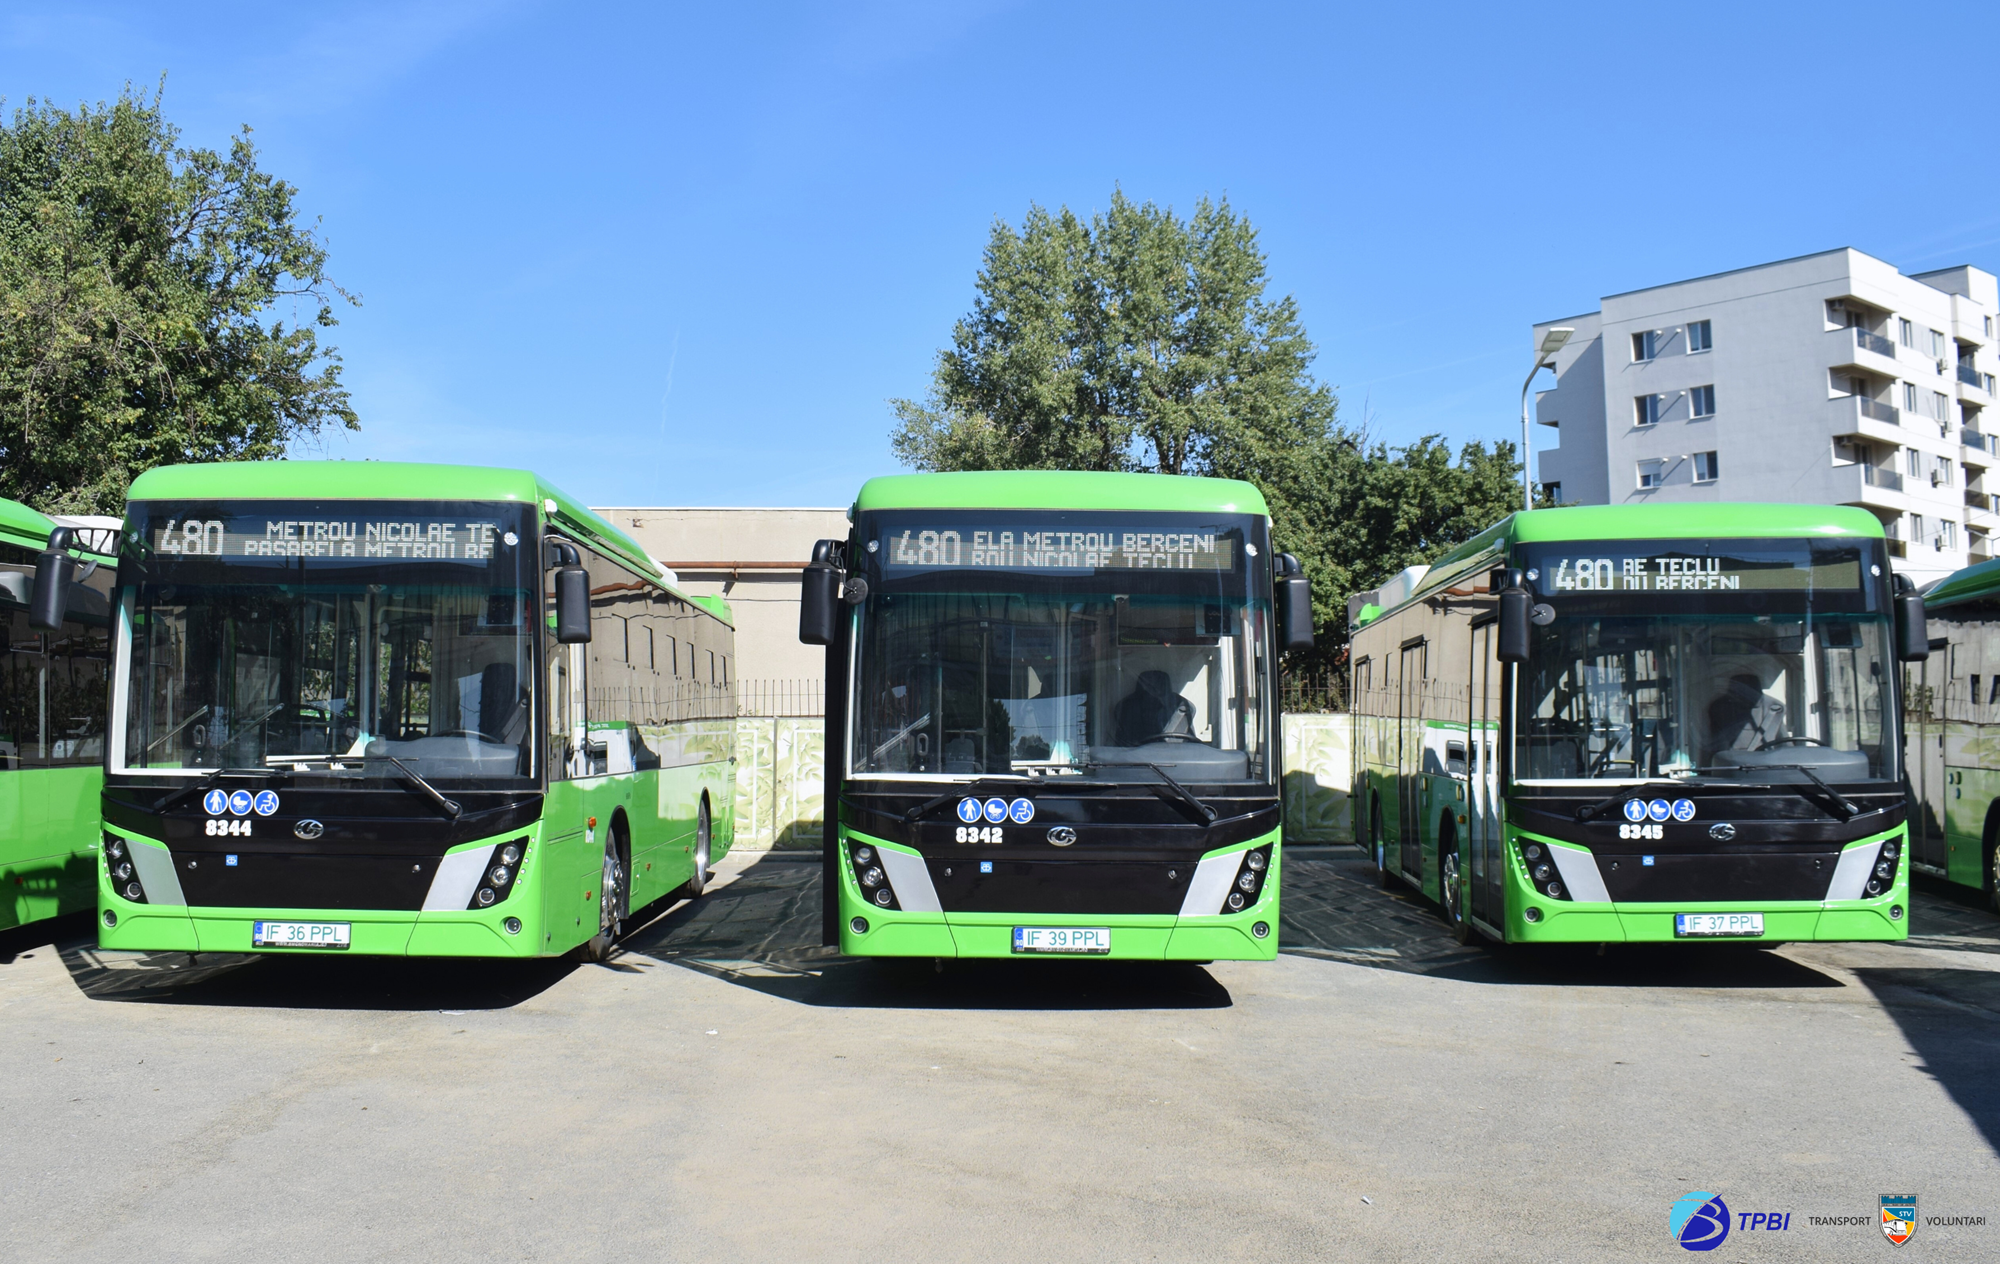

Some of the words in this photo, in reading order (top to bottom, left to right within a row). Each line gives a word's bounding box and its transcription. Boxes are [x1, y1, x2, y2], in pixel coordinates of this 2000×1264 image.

[161, 520, 223, 554] 480
[266, 521, 356, 540] METROU
[365, 522, 455, 542] NICOLAE
[465, 523, 495, 543] TE
[897, 530, 961, 565] 480
[973, 531, 1014, 550] ELA
[1023, 532, 1113, 551] METROU
[1123, 533, 1215, 553] BERCENI
[1555, 558, 1614, 590] 480
[1623, 558, 1648, 576] AE
[1655, 558, 1720, 576] TECLU
[205, 819, 252, 837] 8344
[955, 826, 1003, 844] 8342
[1619, 824, 1663, 840] 8345
[1689, 916, 1702, 931] IF
[1709, 916, 1725, 930] 37
[1729, 915, 1759, 930] PPL
[266, 924, 281, 940] IF
[287, 925, 306, 941] 36
[310, 925, 342, 942] PPL
[1027, 930, 1042, 946] IF
[1048, 931, 1067, 946] 39
[1072, 931, 1104, 946] PPL
